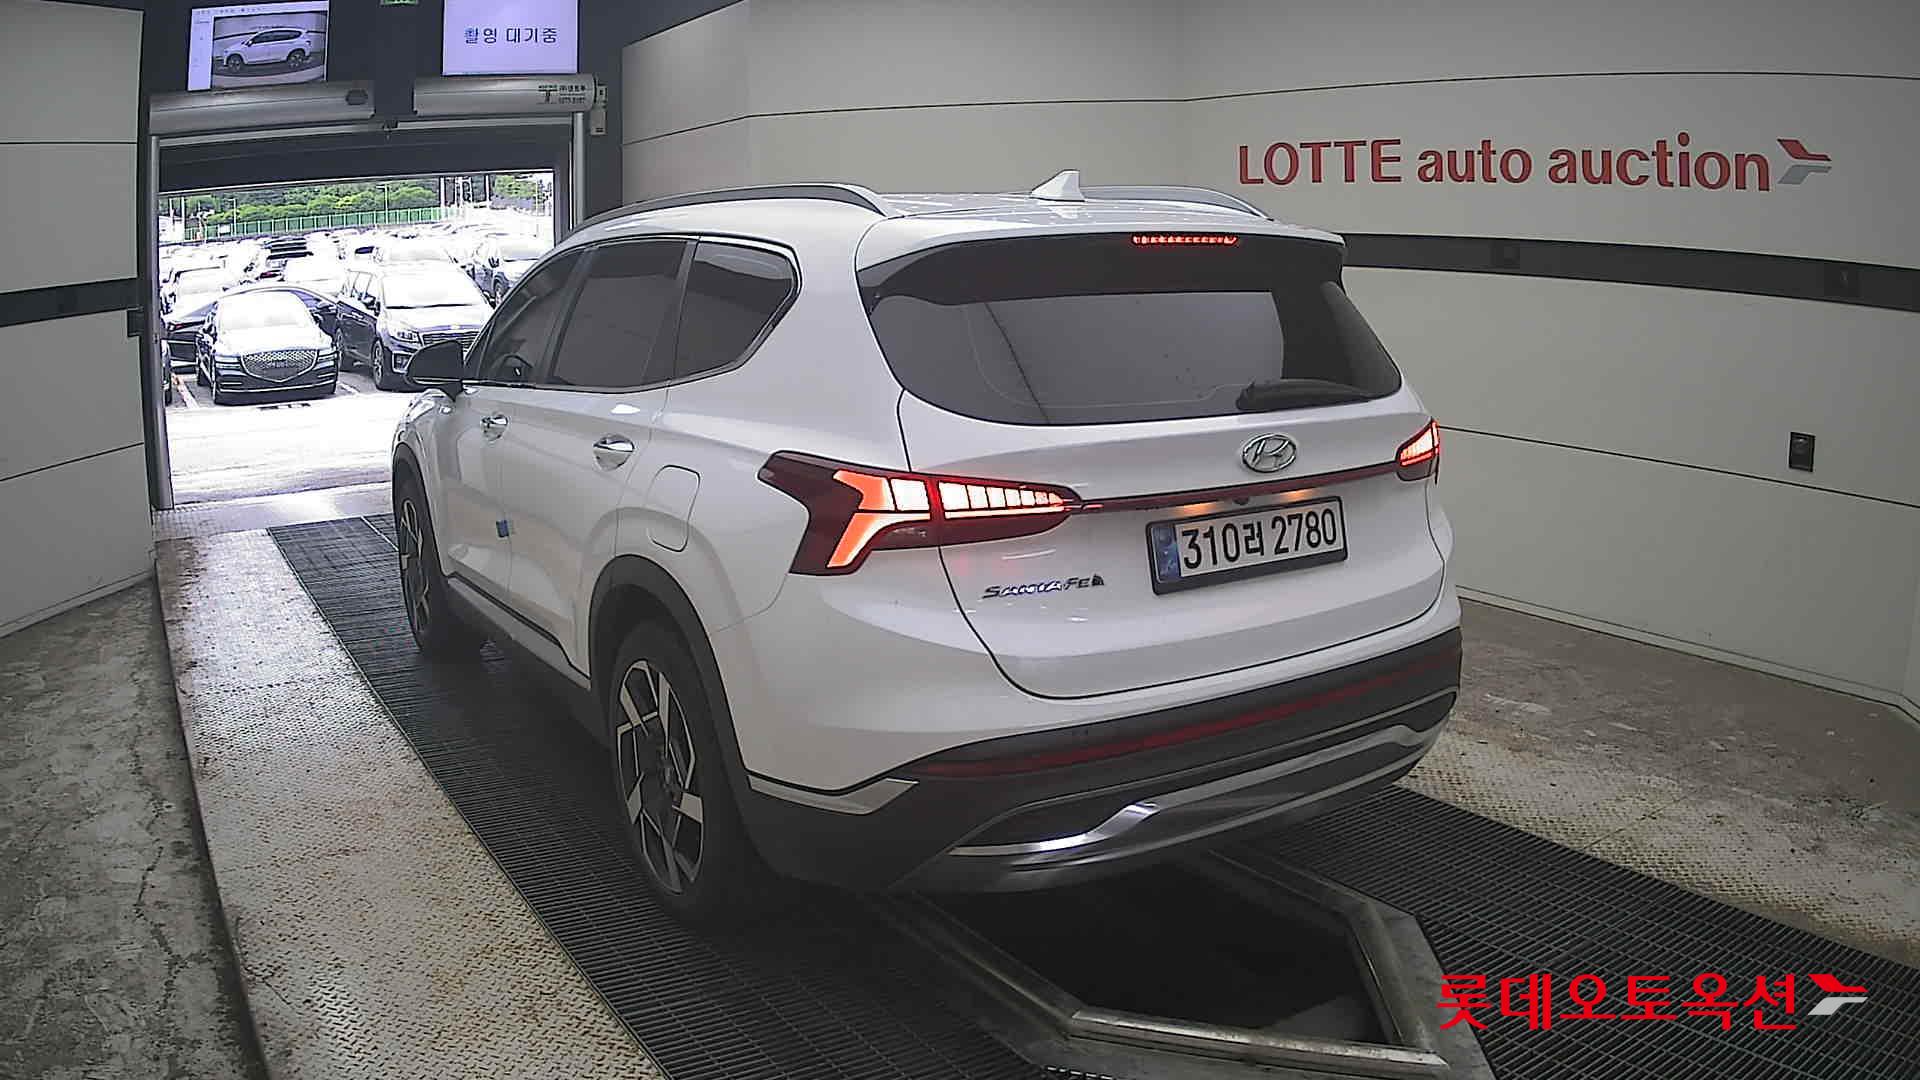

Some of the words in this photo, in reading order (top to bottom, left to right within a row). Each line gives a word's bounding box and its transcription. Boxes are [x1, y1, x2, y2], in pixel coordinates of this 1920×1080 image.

[464, 27, 498, 44] 촬영
[506, 27, 558, 44] 대기중
[1238, 138, 1401, 186] LOTTE
[1416, 138, 1533, 185] auto
[1548, 132, 1772, 192] auction
[1181, 520, 1265, 570] 310러
[1271, 508, 1338, 555] 2780
